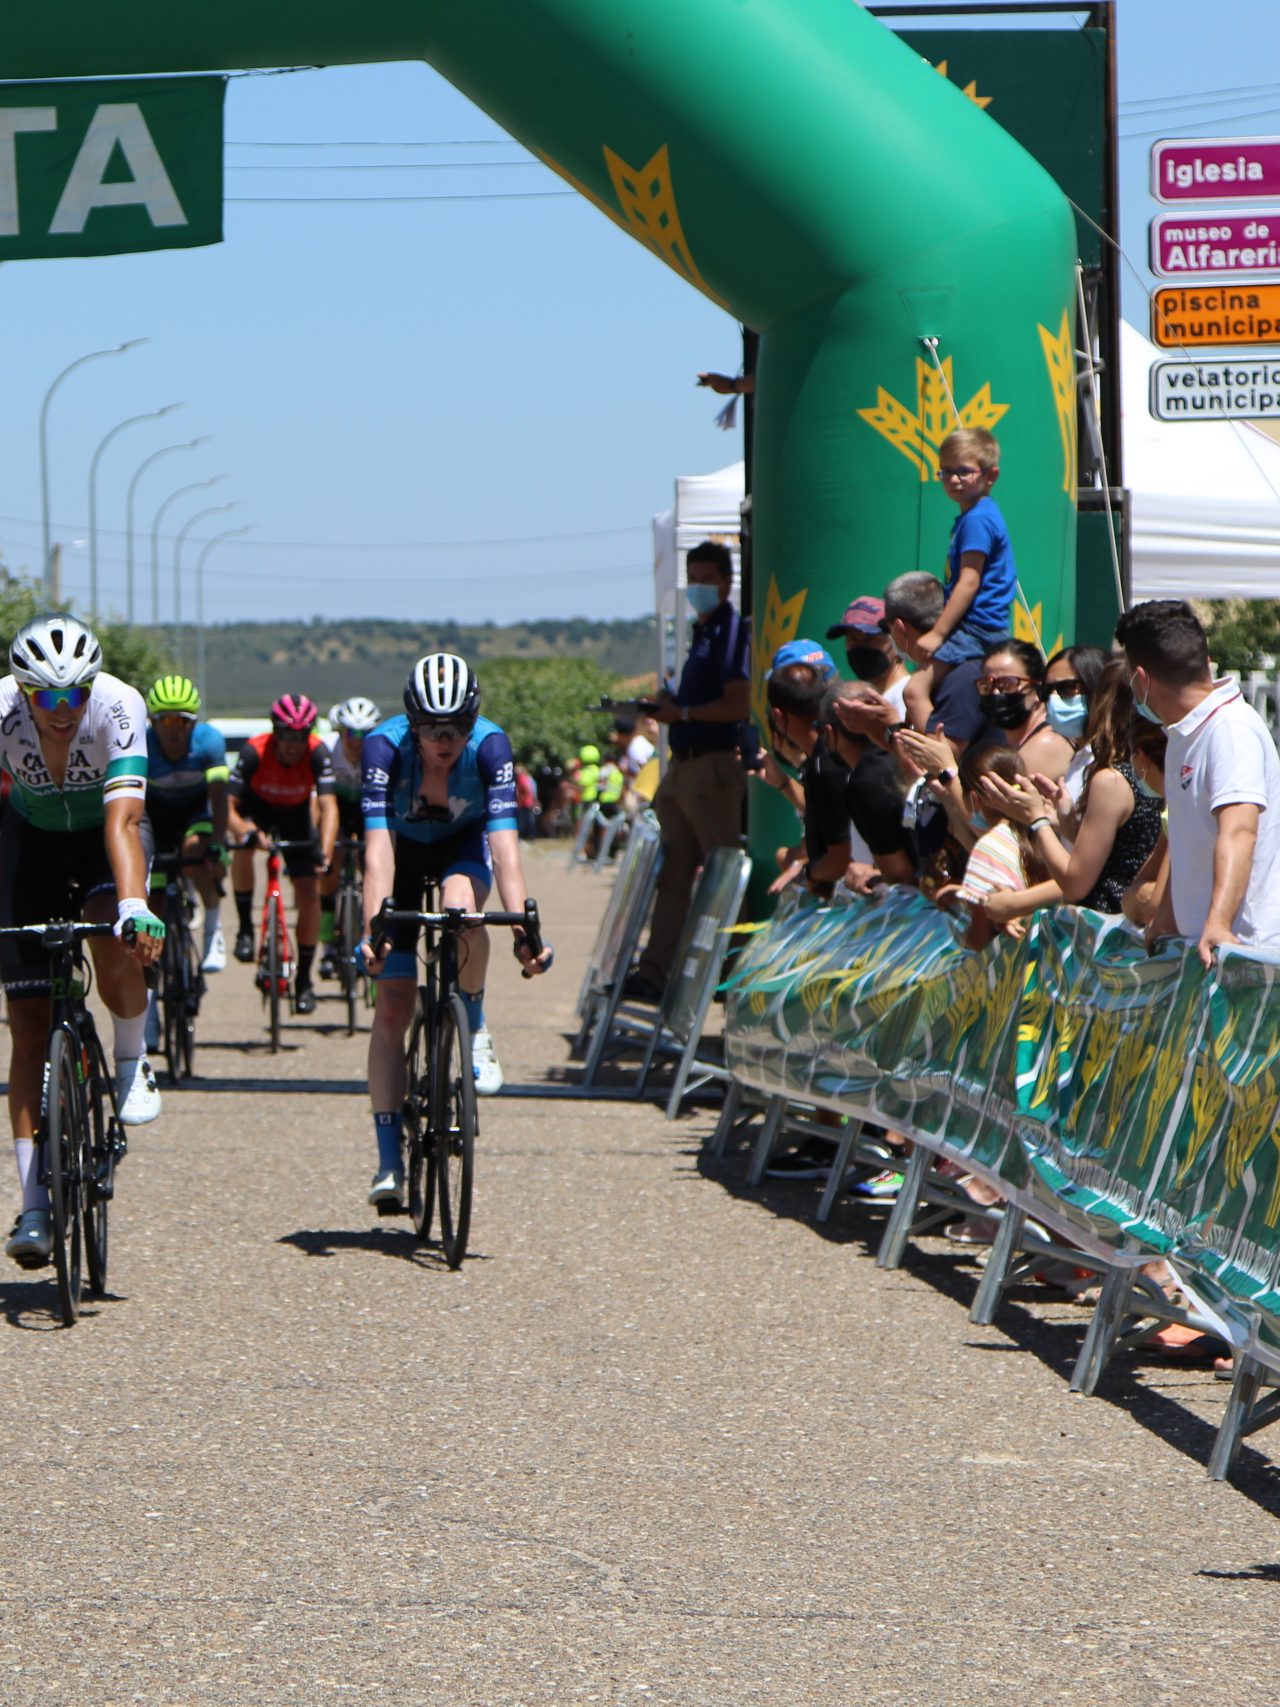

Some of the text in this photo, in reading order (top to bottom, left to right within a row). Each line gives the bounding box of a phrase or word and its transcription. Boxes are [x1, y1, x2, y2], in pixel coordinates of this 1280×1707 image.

[1166, 156, 1264, 188] iglesia
[1165, 221, 1270, 243] museo de
[1167, 241, 1280, 270] Alfareri
[1163, 289, 1260, 316] piscina
[1166, 387, 1280, 411] municip
